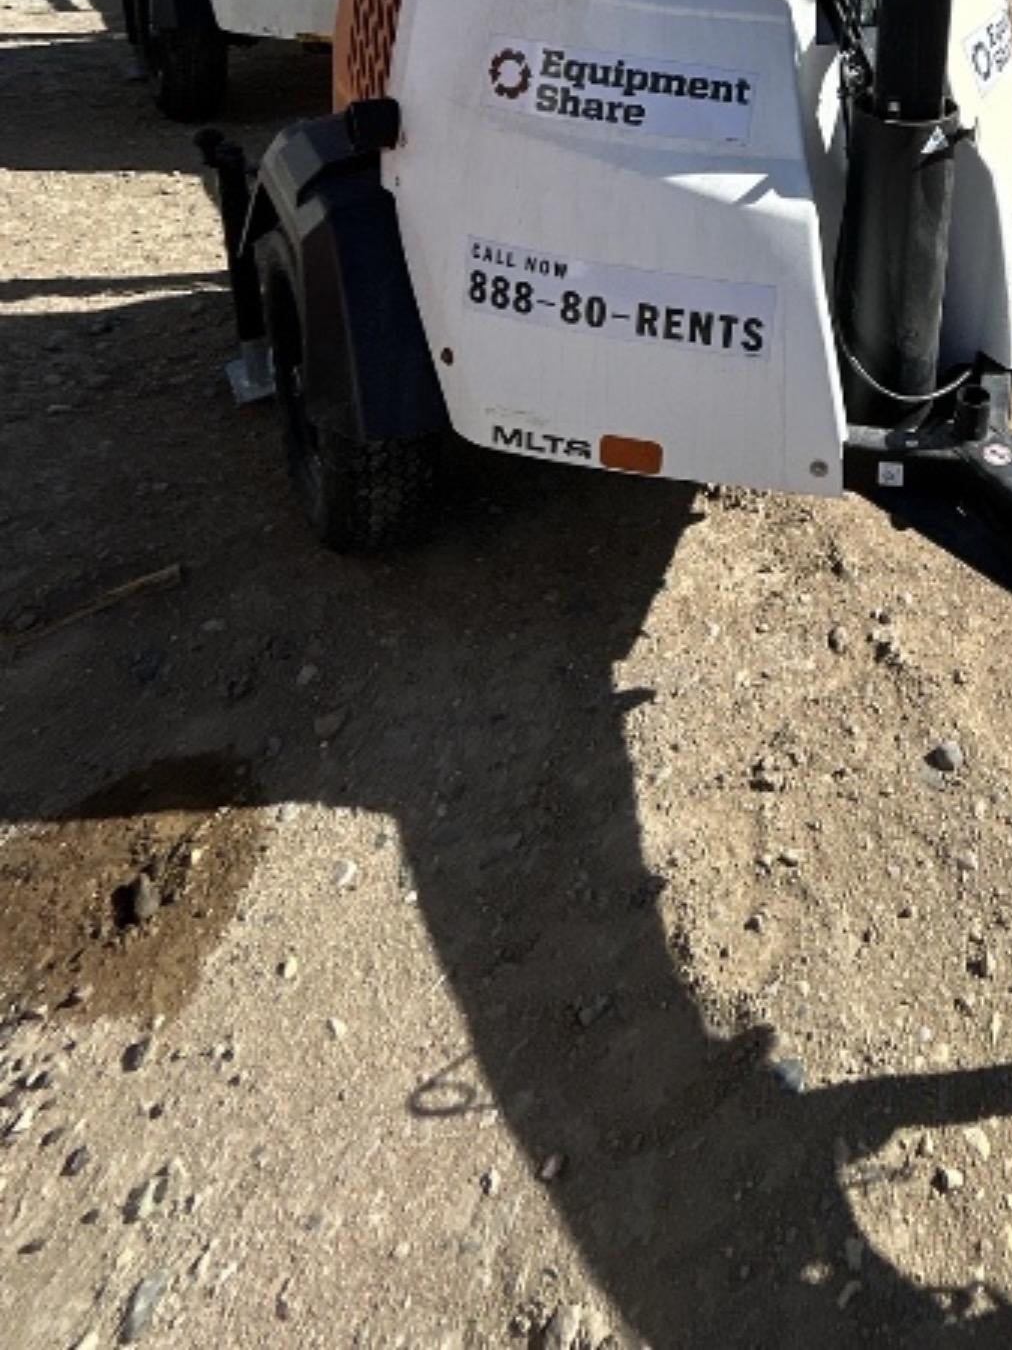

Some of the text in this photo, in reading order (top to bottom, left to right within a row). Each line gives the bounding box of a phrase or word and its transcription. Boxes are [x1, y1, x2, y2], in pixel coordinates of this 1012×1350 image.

[540, 47, 752, 105] Equipment
[535, 83, 646, 127] Share
[471, 242, 569, 280] CALL NOW
[468, 269, 765, 353] 888-80-RENTS
